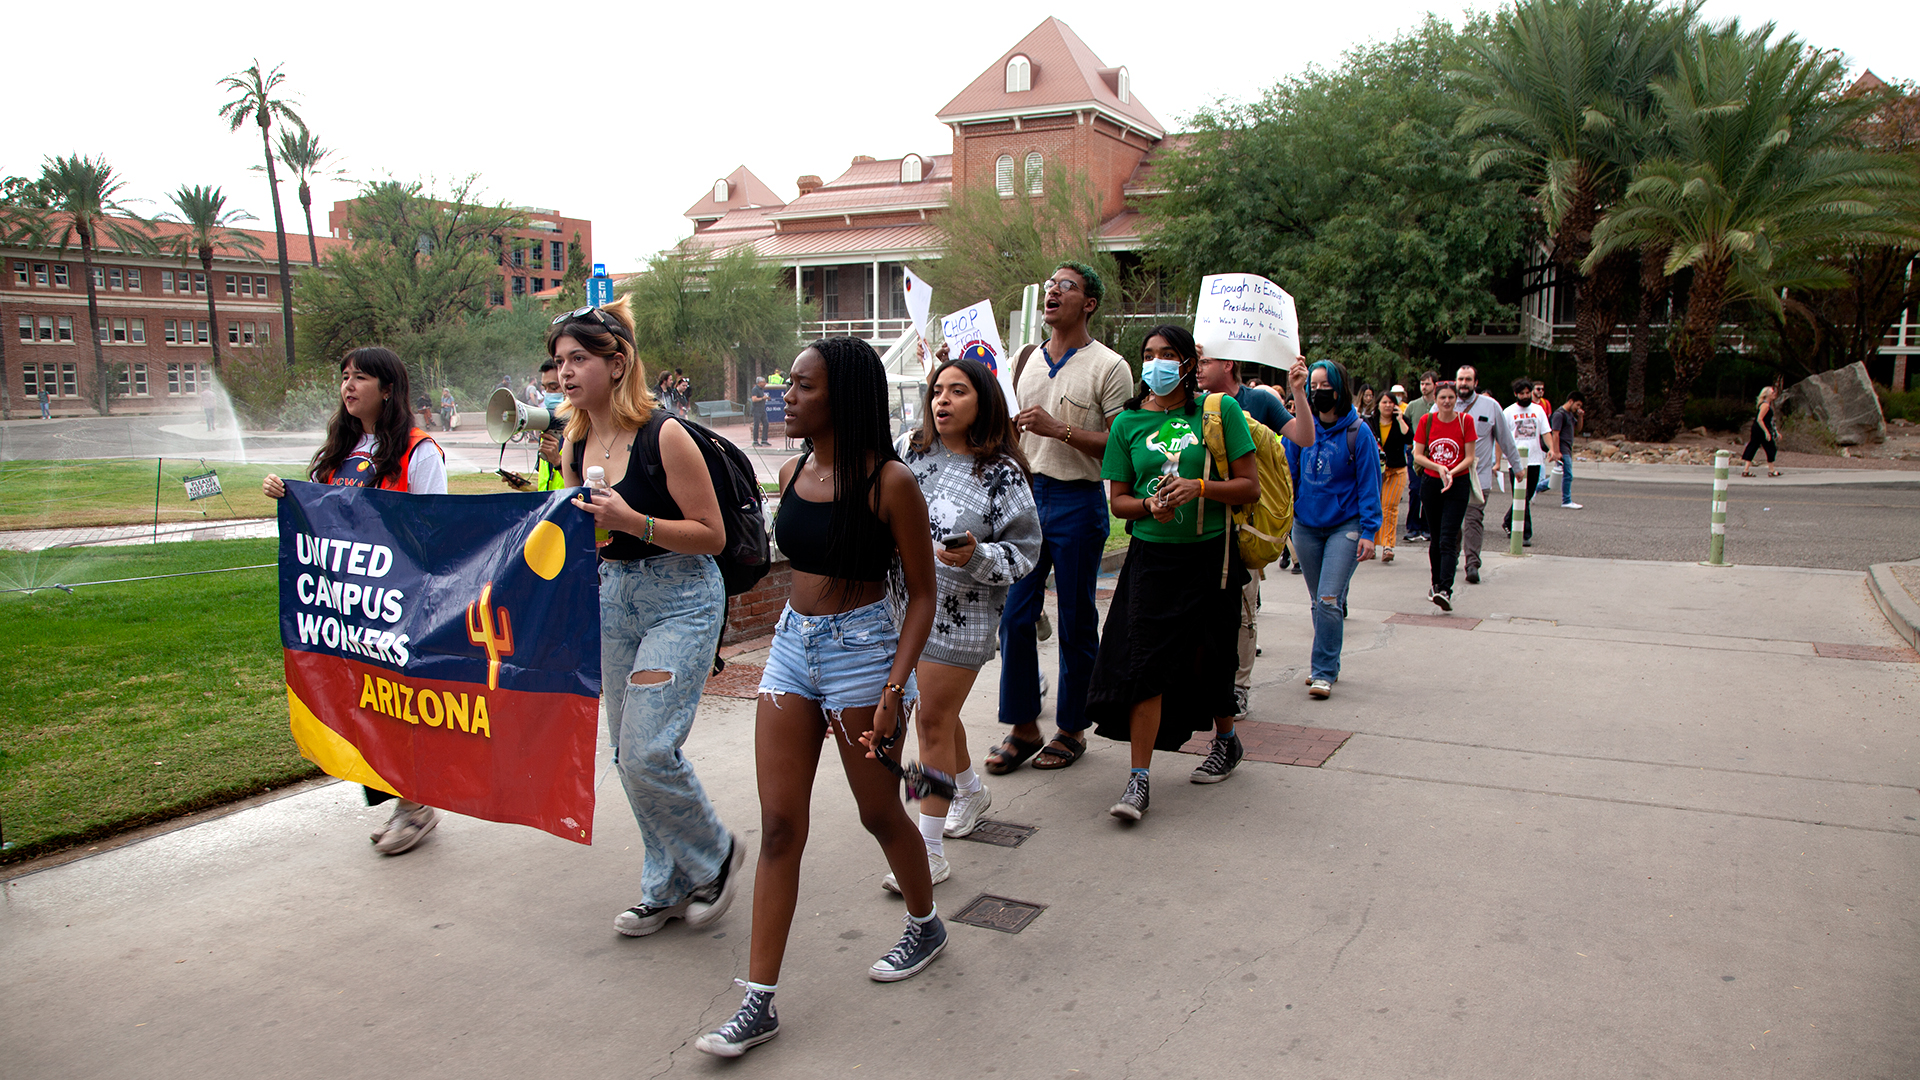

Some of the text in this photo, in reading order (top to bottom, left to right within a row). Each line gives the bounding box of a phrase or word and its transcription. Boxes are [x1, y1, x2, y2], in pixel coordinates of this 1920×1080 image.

[1210, 277, 1249, 299] Enough
[1253, 283, 1261, 294] is
[943, 308, 978, 338] CHOP
[1223, 299, 1283, 320] President Robbins!
[1513, 412, 1537, 420] FELA
[296, 532, 394, 578] UNITED
[296, 573, 404, 623] CAMPUS
[297, 612, 410, 667] WORKERS
[359, 673, 491, 738] ARIZONA
